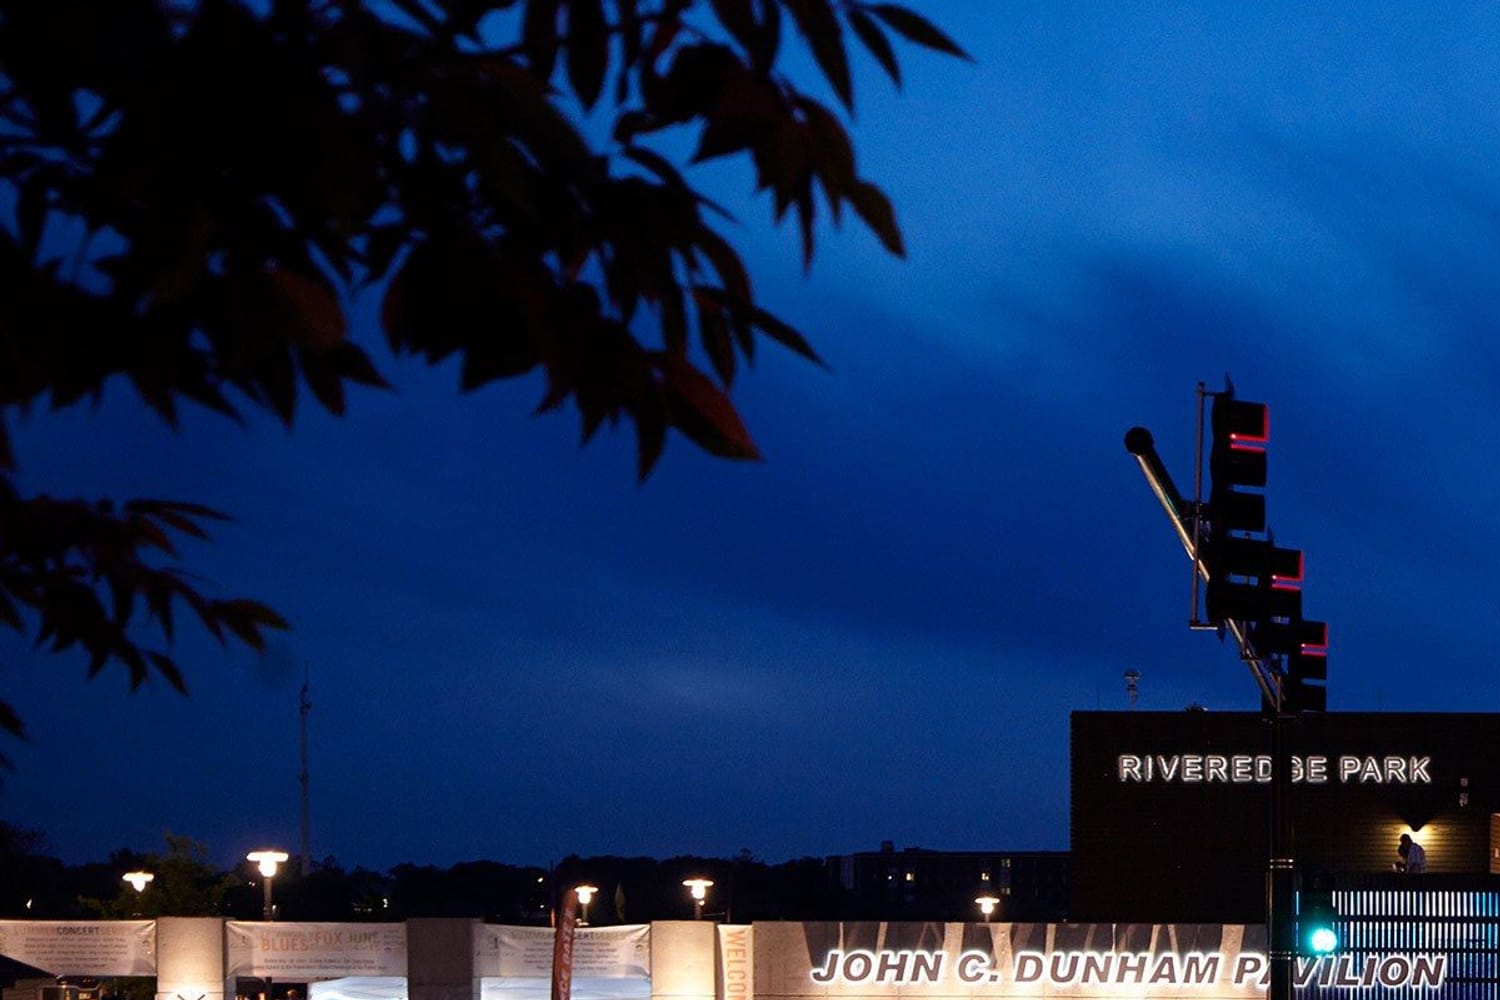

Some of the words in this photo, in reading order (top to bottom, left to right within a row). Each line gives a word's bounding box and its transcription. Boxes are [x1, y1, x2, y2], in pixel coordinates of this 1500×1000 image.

[1118, 755, 1328, 784] RIVEREDGE
[1339, 755, 1432, 784] PARK
[261, 936, 308, 951] BLUES
[316, 931, 342, 945] FOX
[811, 952, 943, 983] JOHN
[957, 953, 999, 983] C.
[1014, 953, 1221, 985] DUNHAM
[1234, 955, 1446, 986] PVILION
